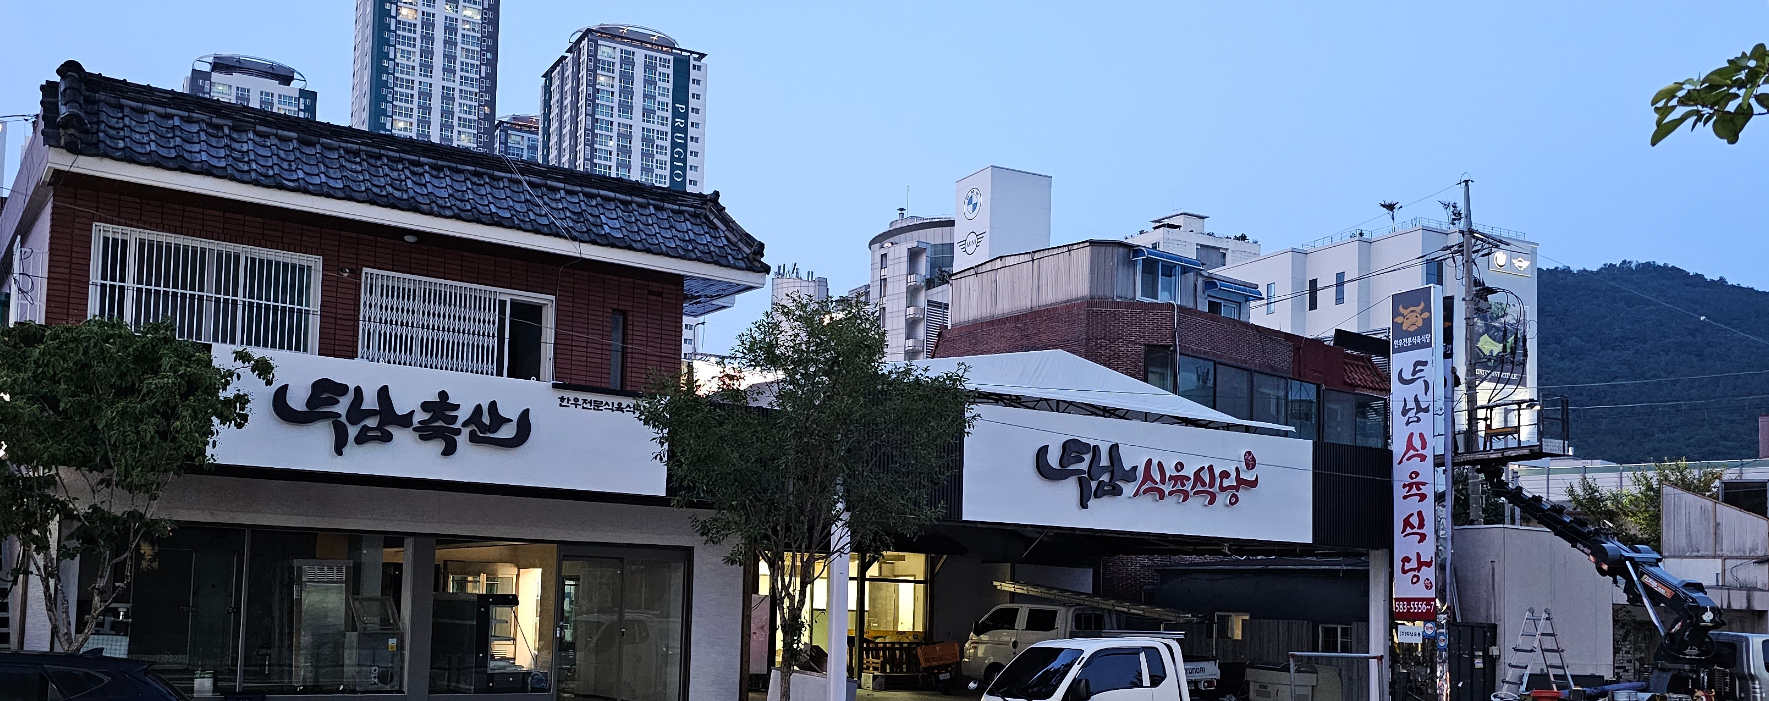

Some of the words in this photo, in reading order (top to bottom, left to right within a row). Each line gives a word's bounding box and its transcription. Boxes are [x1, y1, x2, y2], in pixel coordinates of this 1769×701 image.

[673, 103, 686, 182] PRUGIO
[558, 395, 637, 415] 한우전문식육식
[1395, 601, 1435, 613] 583-5556~7
[1184, 666, 1206, 675] YUNDAI
